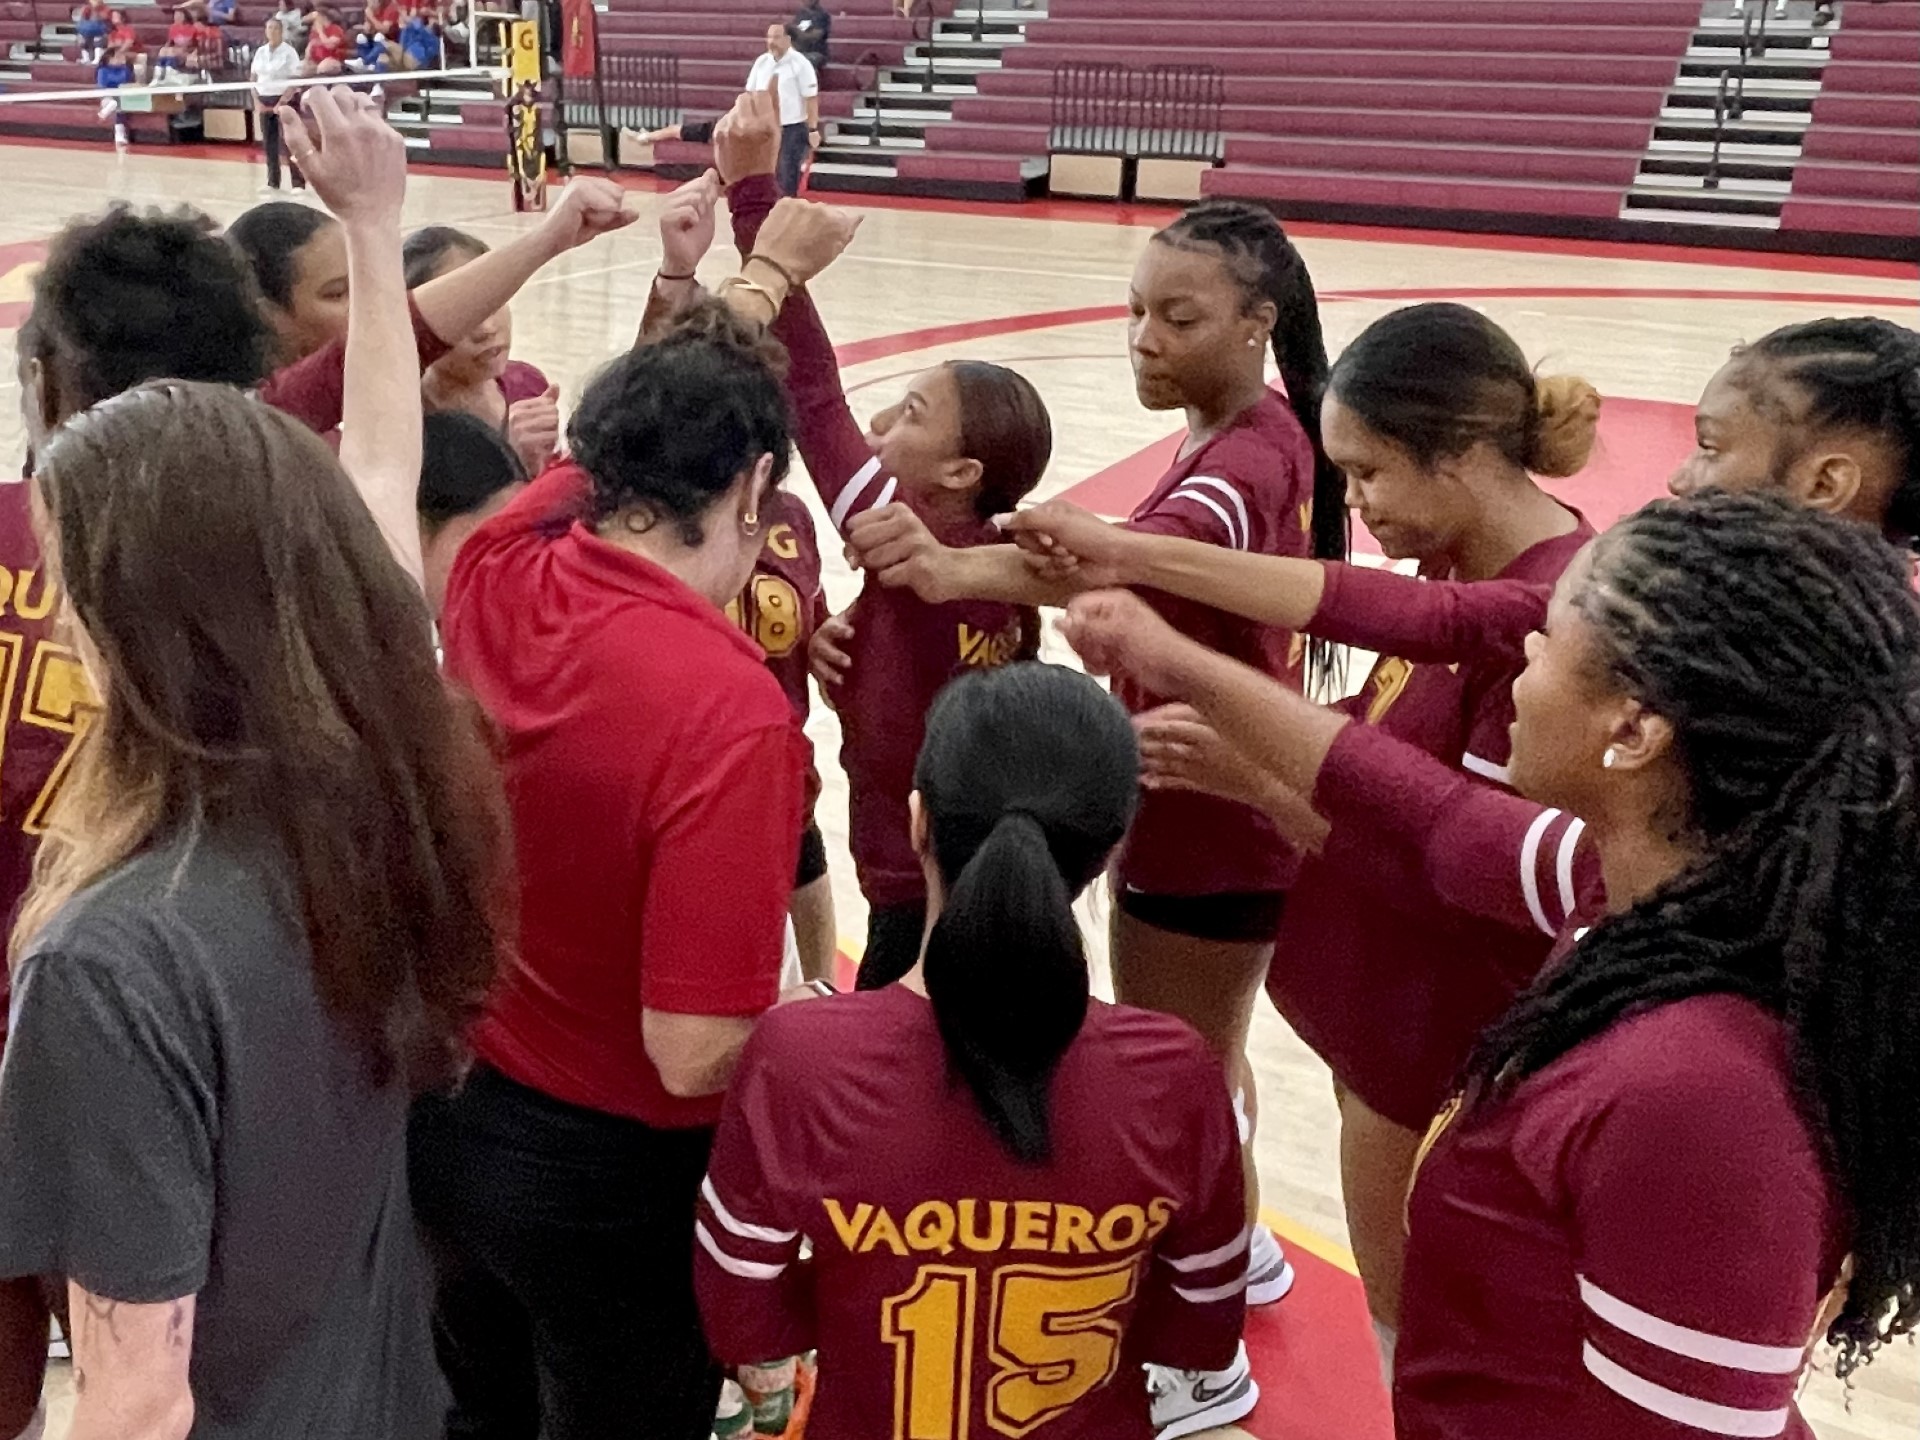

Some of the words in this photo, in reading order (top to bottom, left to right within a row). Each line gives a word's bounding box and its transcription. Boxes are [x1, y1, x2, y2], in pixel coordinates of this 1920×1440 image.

[519, 29, 534, 51] G
[822, 1196, 1182, 1256] VAQUEROS
[880, 1252, 1141, 1440] 15
